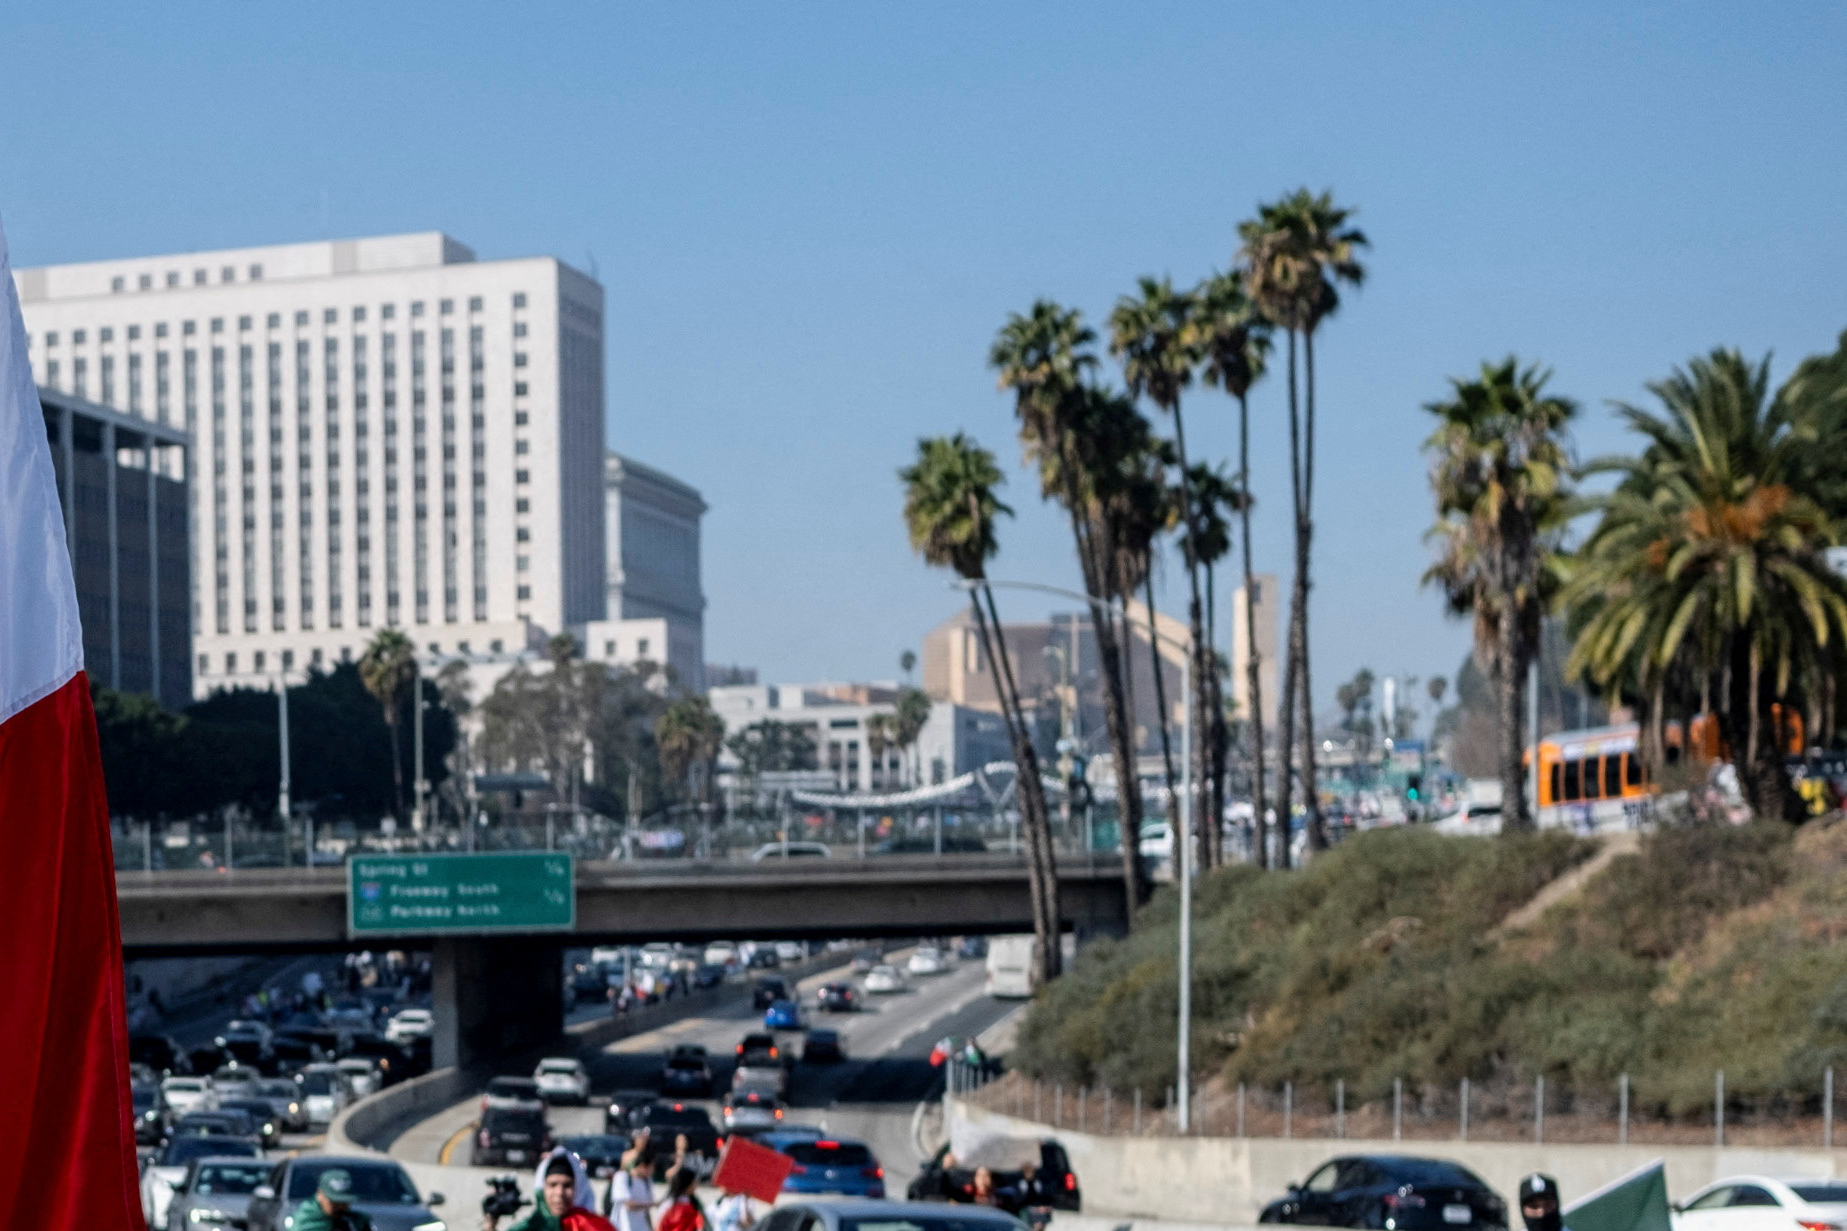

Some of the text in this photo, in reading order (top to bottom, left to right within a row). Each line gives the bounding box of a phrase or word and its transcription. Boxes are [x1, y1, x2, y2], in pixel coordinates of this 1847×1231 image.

[457, 882, 499, 896] South
[390, 904, 453, 918] Parkway
[457, 903, 501, 917] North
